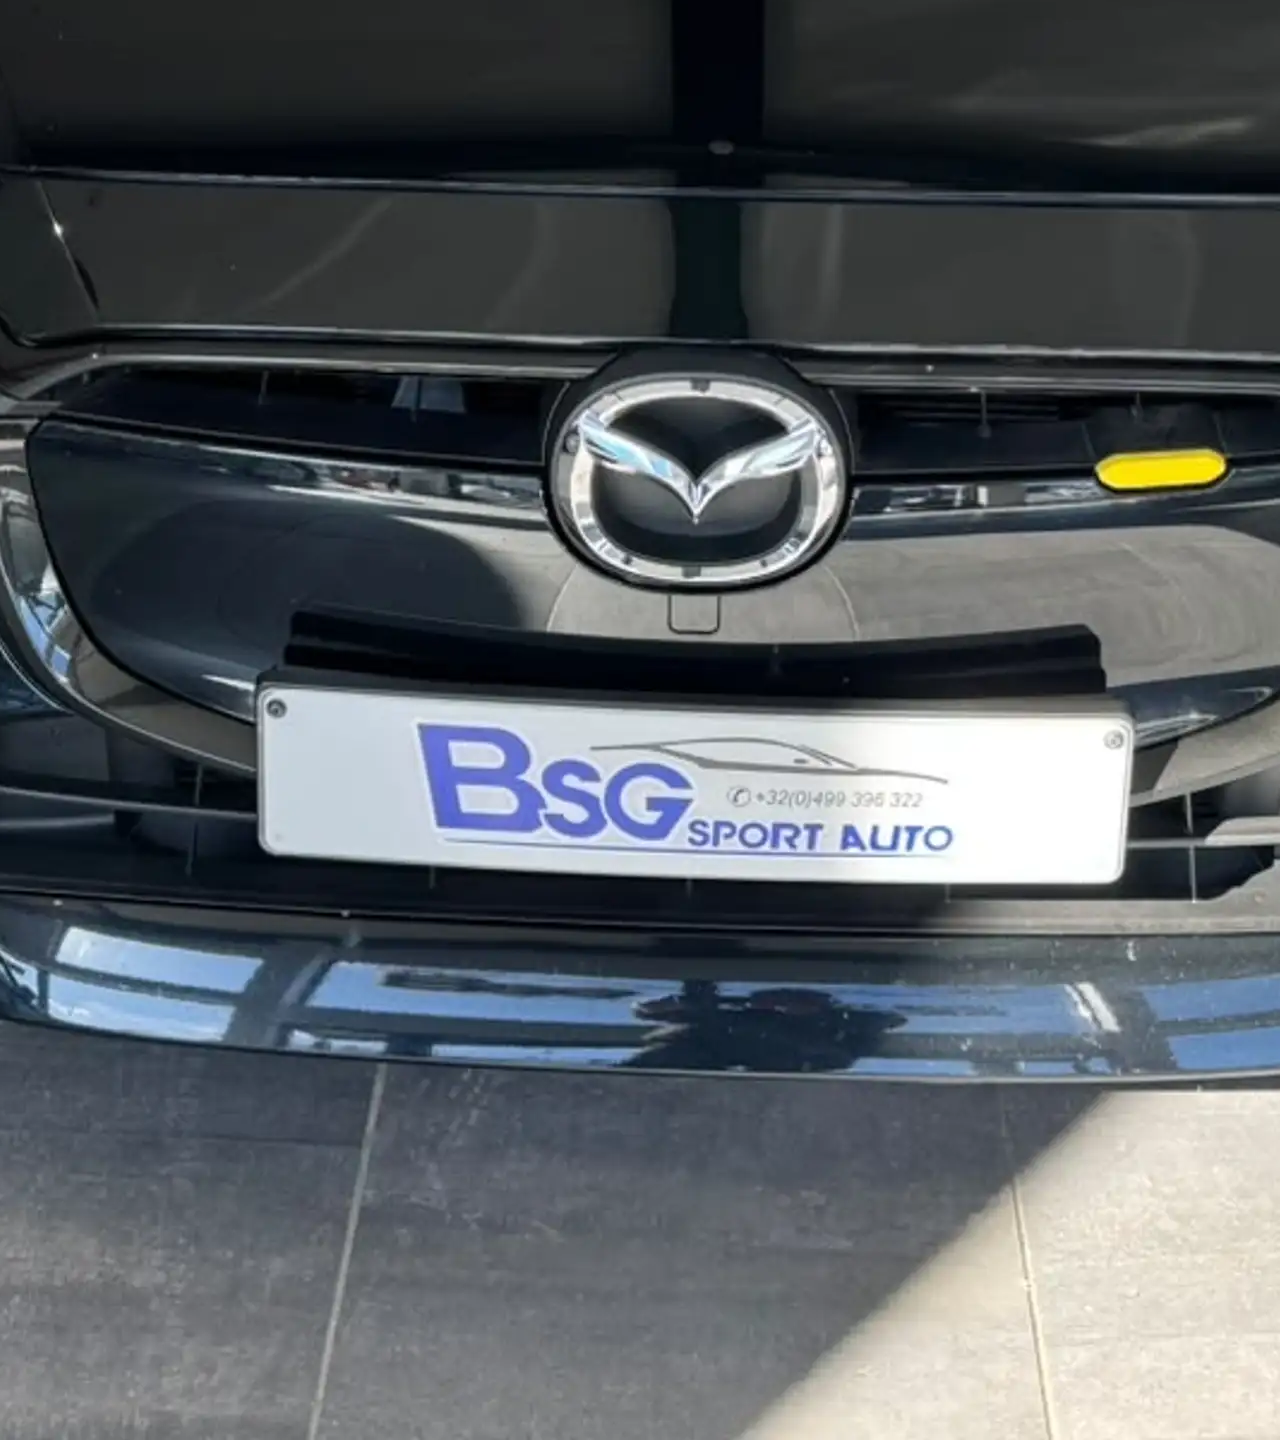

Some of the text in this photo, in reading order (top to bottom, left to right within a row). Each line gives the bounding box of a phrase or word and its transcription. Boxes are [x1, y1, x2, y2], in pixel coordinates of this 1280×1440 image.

[417, 723, 954, 852] BSG SPORT AUTO
[889, 790, 924, 809] 322
